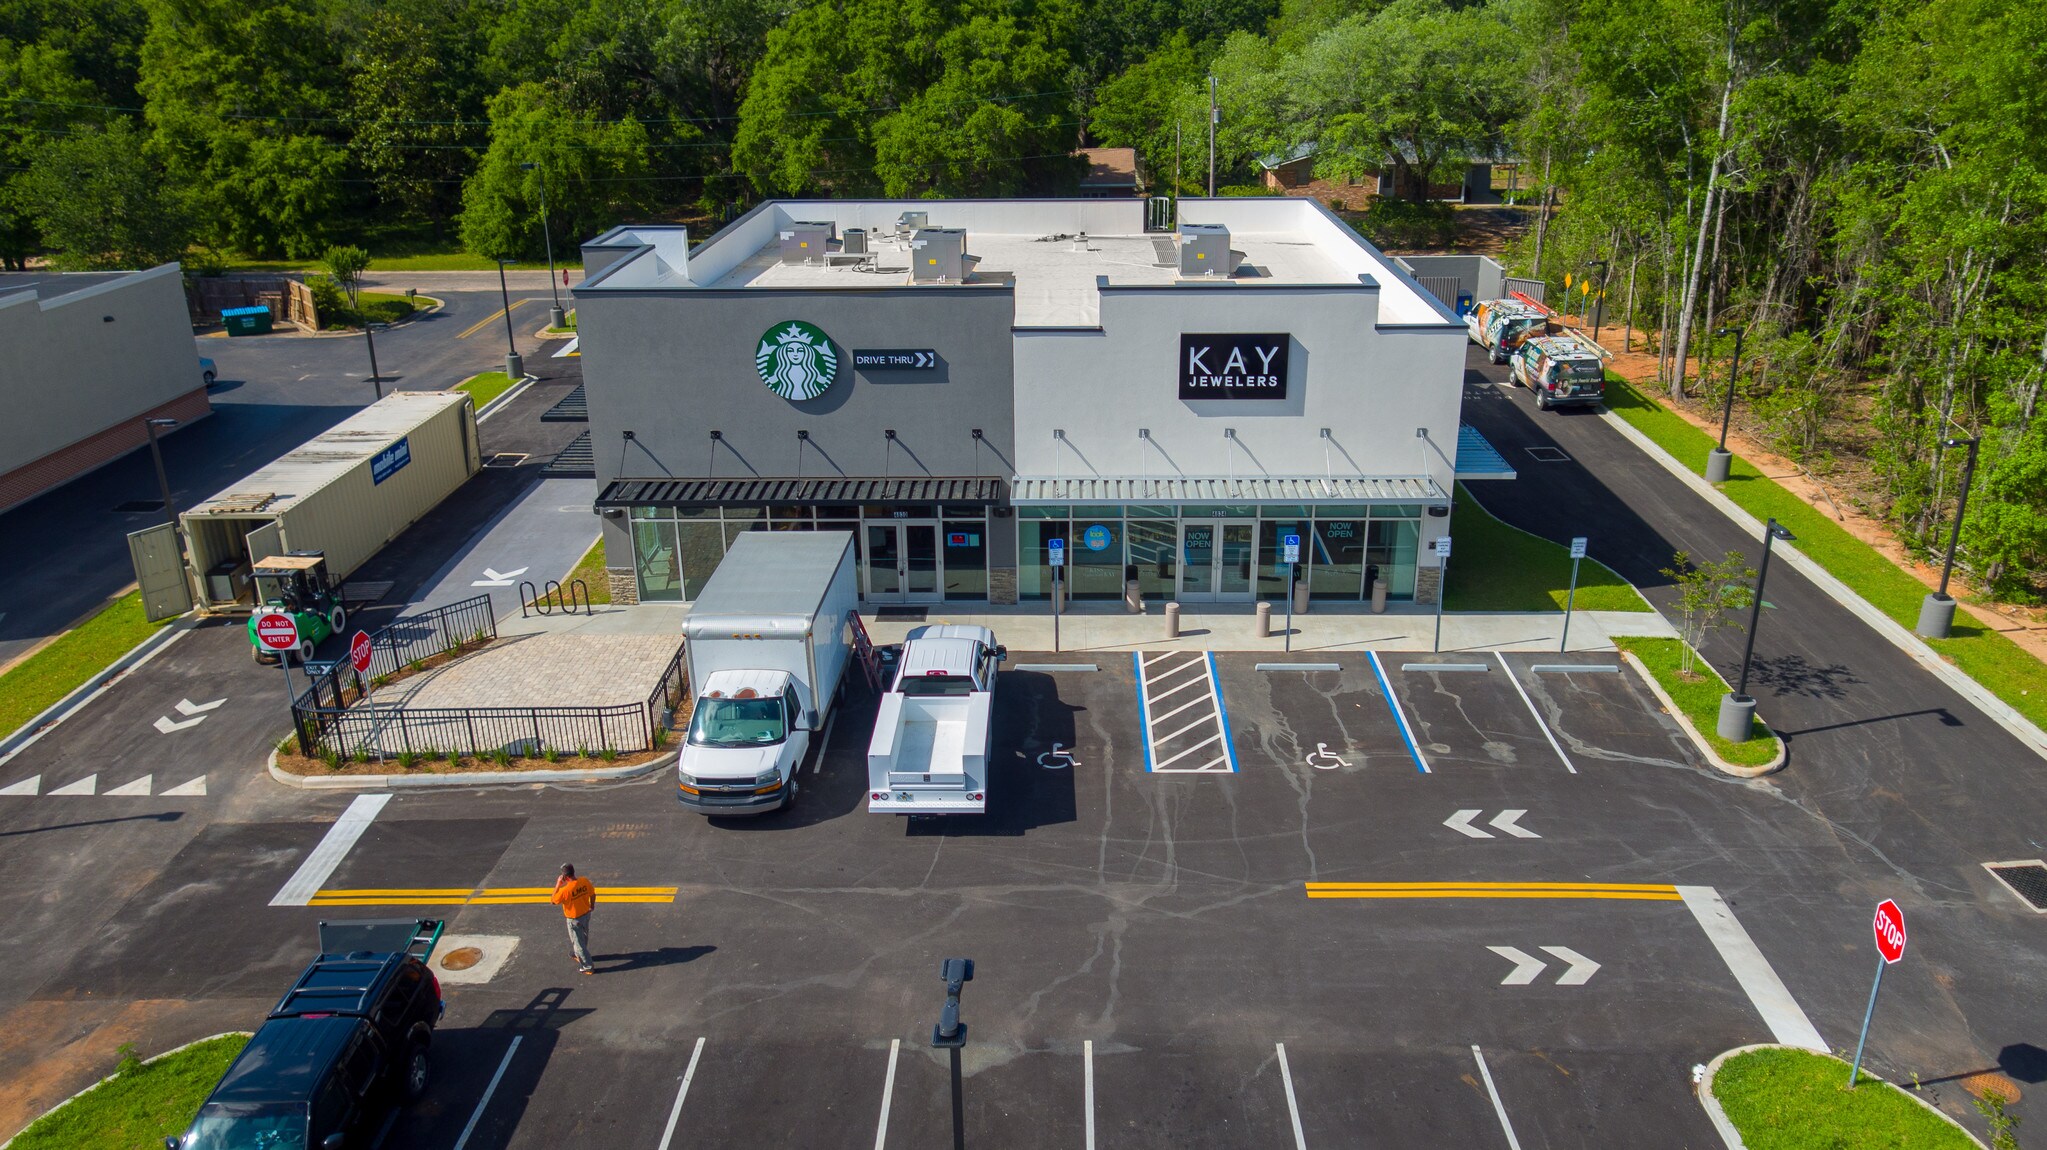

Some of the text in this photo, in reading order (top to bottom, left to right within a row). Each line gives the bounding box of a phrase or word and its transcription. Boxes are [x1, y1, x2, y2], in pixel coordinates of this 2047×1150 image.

[856, 355, 914, 364] DRIVE THRU
[1189, 346, 1280, 375] KAY
[1189, 376, 1278, 387] JEWELERS
[1329, 522, 1352, 530] NOW
[1187, 532, 1210, 540] NOW
[1327, 530, 1353, 538] OPEN
[1185, 540, 1211, 548] OPEN
[353, 640, 370, 665] STOP
[1876, 910, 1904, 950] STOP
